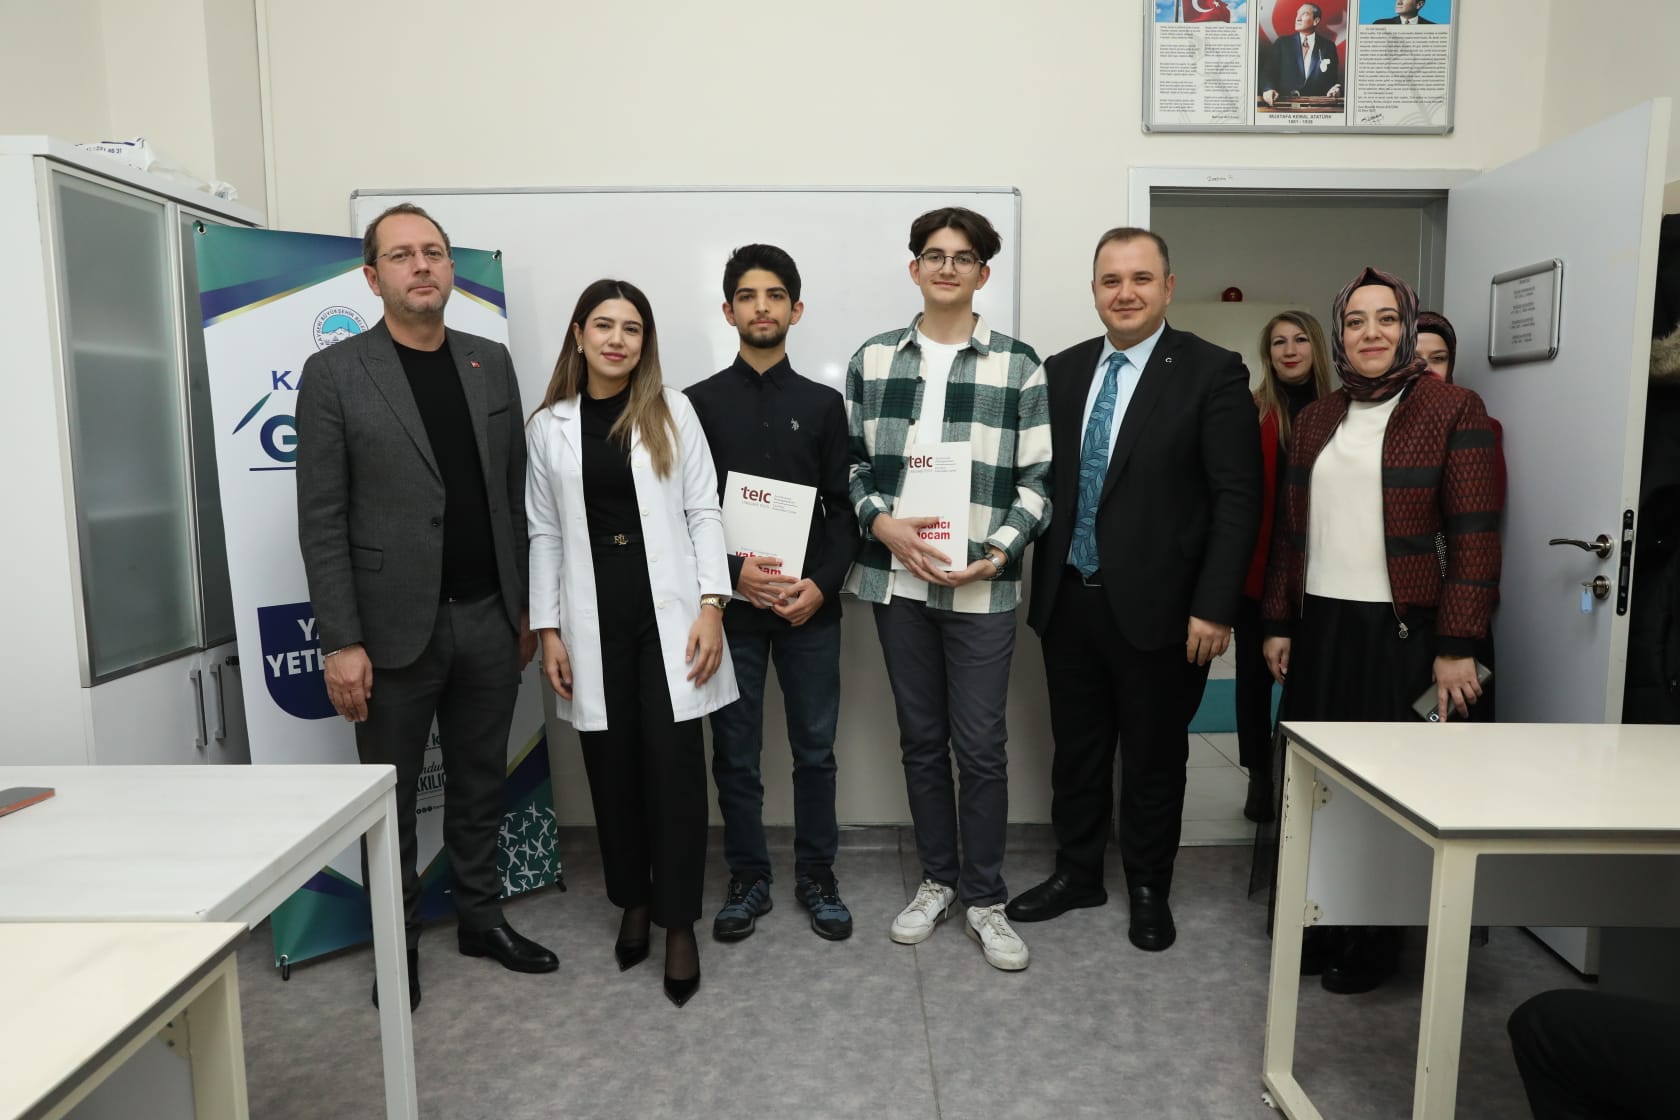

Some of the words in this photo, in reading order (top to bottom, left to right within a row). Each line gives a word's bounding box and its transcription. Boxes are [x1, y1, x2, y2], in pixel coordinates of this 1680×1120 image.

[271, 370, 304, 391] K
[909, 455, 933, 469] telc
[741, 486, 772, 504] telc
[916, 531, 951, 540] ocam
[296, 617, 320, 642] Y
